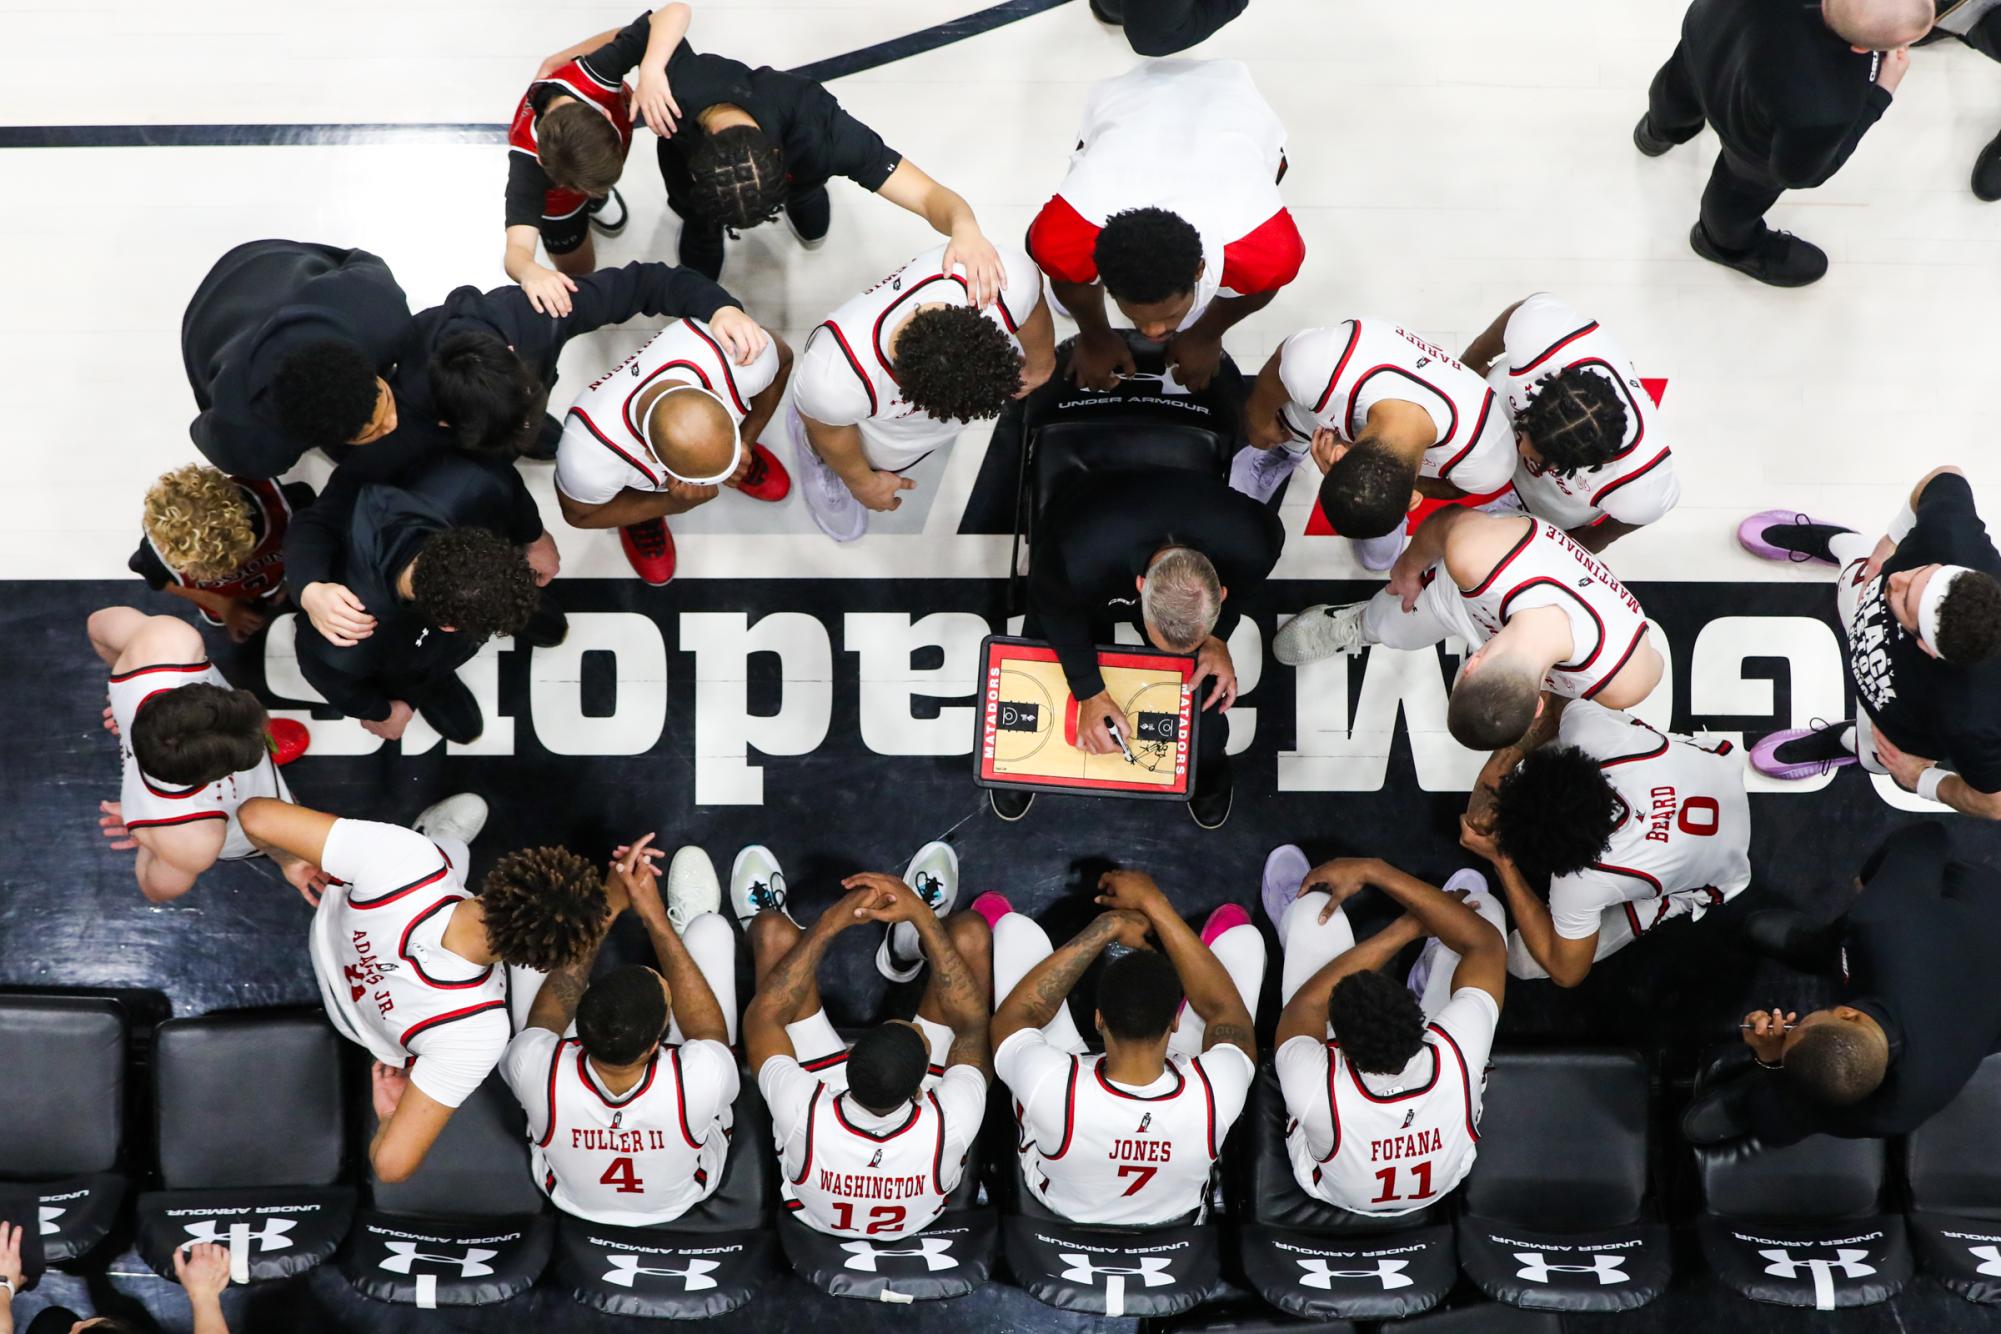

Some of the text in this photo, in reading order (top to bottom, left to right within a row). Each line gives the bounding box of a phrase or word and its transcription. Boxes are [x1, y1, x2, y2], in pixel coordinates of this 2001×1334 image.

[1058, 397, 1209, 415] UNDER ARMOUR
[1545, 525, 1641, 614] MARTINDALE
[1863, 574, 1897, 699] BLACK
[983, 667, 999, 759] MATADORS
[1175, 683, 1193, 775] MATADORS
[1645, 786, 1677, 843] BEARD
[1677, 796, 1720, 836] 0
[571, 1128, 665, 1153] FULLER II
[1108, 1139, 1172, 1162] JONES
[1371, 1128, 1443, 1162] FOFANA
[599, 1157, 645, 1194] 4
[820, 1169, 926, 1201] WASHINGTON
[1116, 1165, 1158, 1197] 7
[1371, 1160, 1437, 1203] 11
[39, 1189, 90, 1203] UNDE
[166, 1204, 321, 1217] UNDER ARMOUR
[830, 1202, 907, 1235] 12
[368, 1225, 521, 1245] UNDER ARMOUR
[588, 1236, 743, 1255] UNDER ARMOUR
[1036, 1233, 1190, 1254] UNDER ARMOUR
[1273, 1241, 1427, 1257] UNDER ARMOUR
[1490, 1235, 1643, 1251] UNDER ARMOUR
[1736, 1231, 1884, 1247] UNDER ARMOUR
